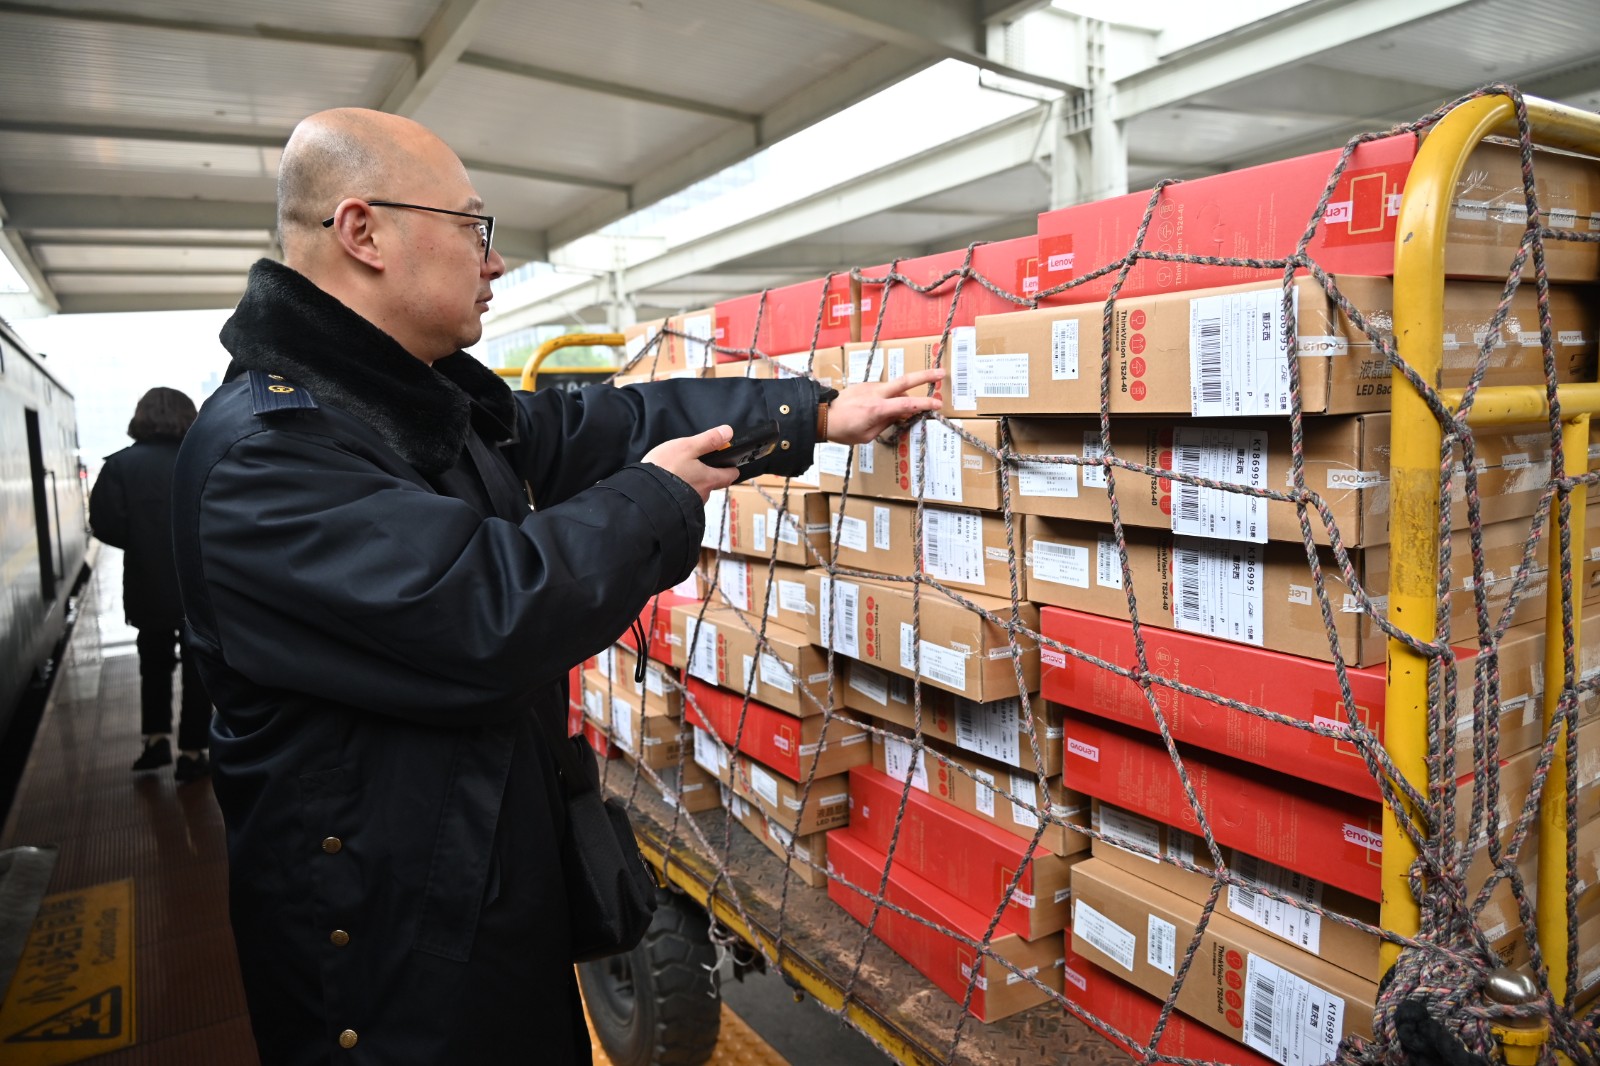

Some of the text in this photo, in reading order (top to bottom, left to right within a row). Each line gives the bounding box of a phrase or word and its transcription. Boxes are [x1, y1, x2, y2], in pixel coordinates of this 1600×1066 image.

[1261, 312, 1271, 341] 重庆西
[1120, 310, 1128, 393] ThinkVision TS24-40
[1356, 384, 1392, 396] LED Bac
[1150, 429, 1158, 468] ThinkVisio
[1236, 448, 1245, 475] 重庆西
[1252, 438, 1261, 487] K186995
[1232, 554, 1241, 579] 重庆西
[1247, 546, 1256, 591] K186995
[1070, 742, 1096, 758] Lenovo
[1217, 944, 1226, 986] ThinkVision
[1309, 1002, 1320, 1030] 重庆西
[1323, 1002, 1335, 1044] K186995
